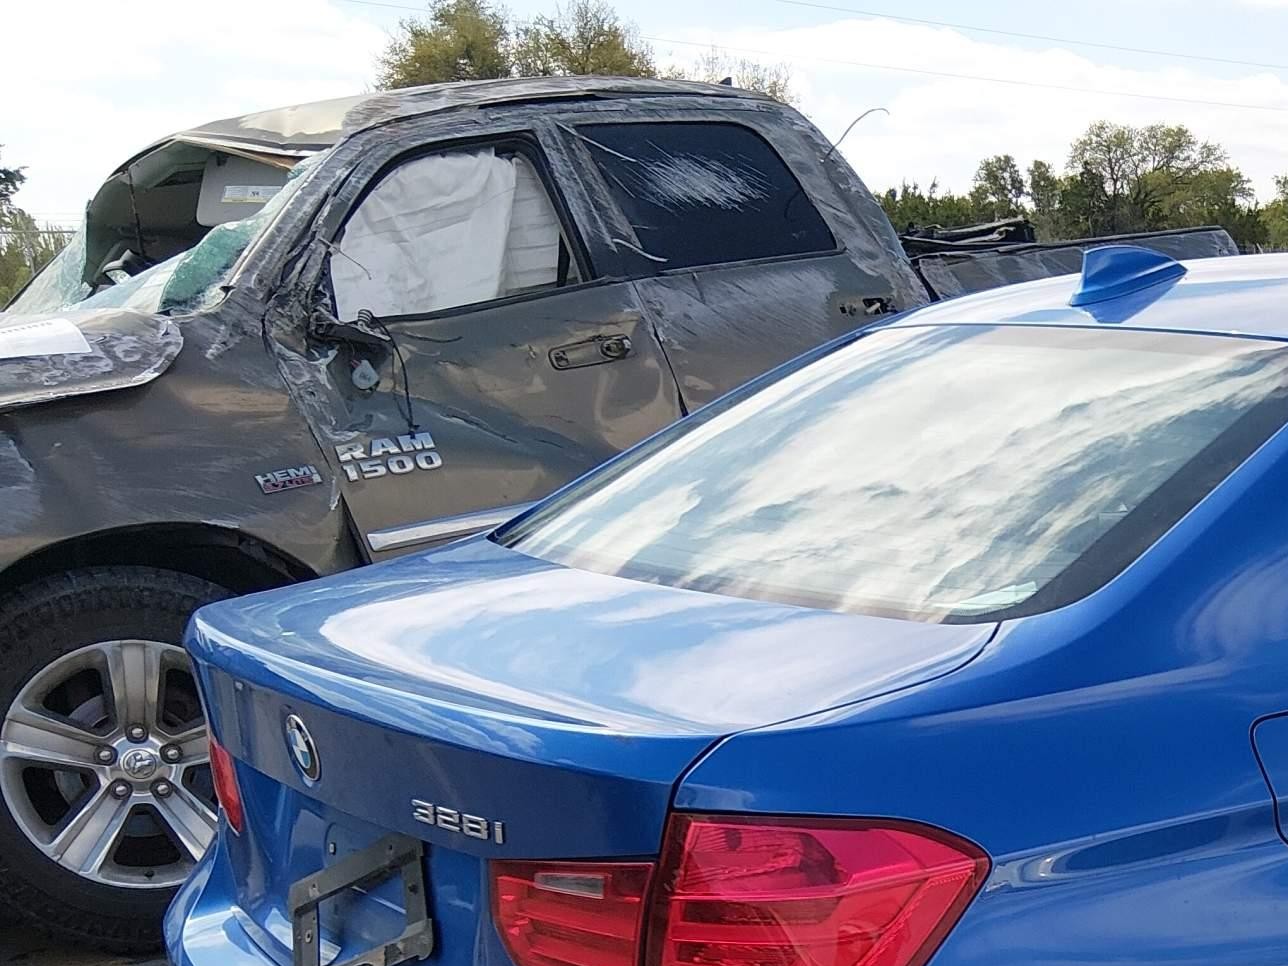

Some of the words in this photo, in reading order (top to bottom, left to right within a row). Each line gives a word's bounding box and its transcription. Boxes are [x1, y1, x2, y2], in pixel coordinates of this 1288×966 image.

[335, 432, 437, 462] RAM
[254, 465, 323, 484] HEMI
[342, 451, 443, 482] 1500
[410, 798, 504, 845] 328i
